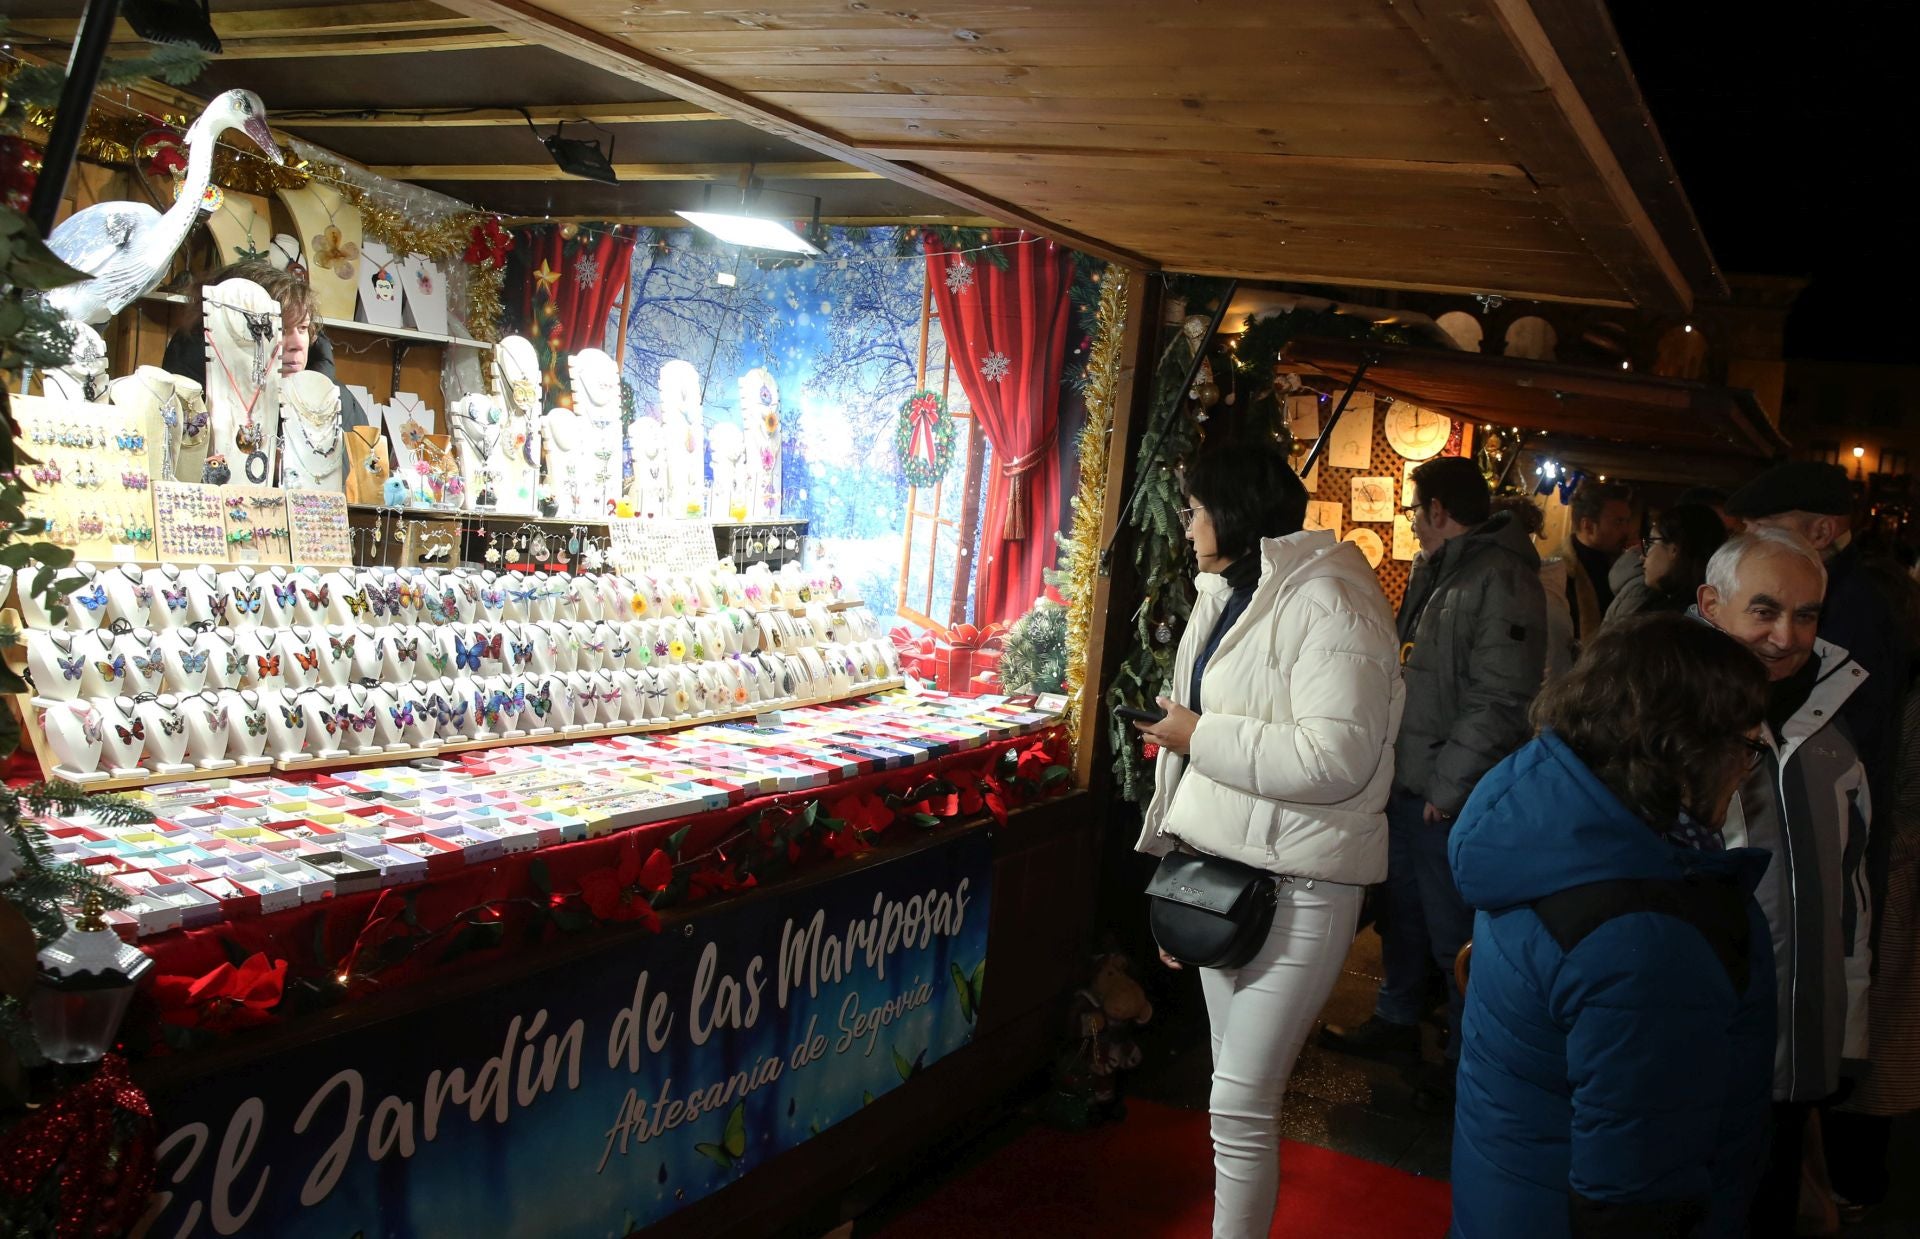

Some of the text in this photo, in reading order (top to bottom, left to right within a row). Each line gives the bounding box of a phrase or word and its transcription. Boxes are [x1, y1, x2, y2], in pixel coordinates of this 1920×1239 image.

[293, 1008, 585, 1207] Jardín
[607, 969, 674, 1073] de
[689, 941, 768, 1046] las
[777, 876, 972, 1009] Mariposas
[790, 1013, 829, 1071] de
[835, 975, 935, 1058] Segovia
